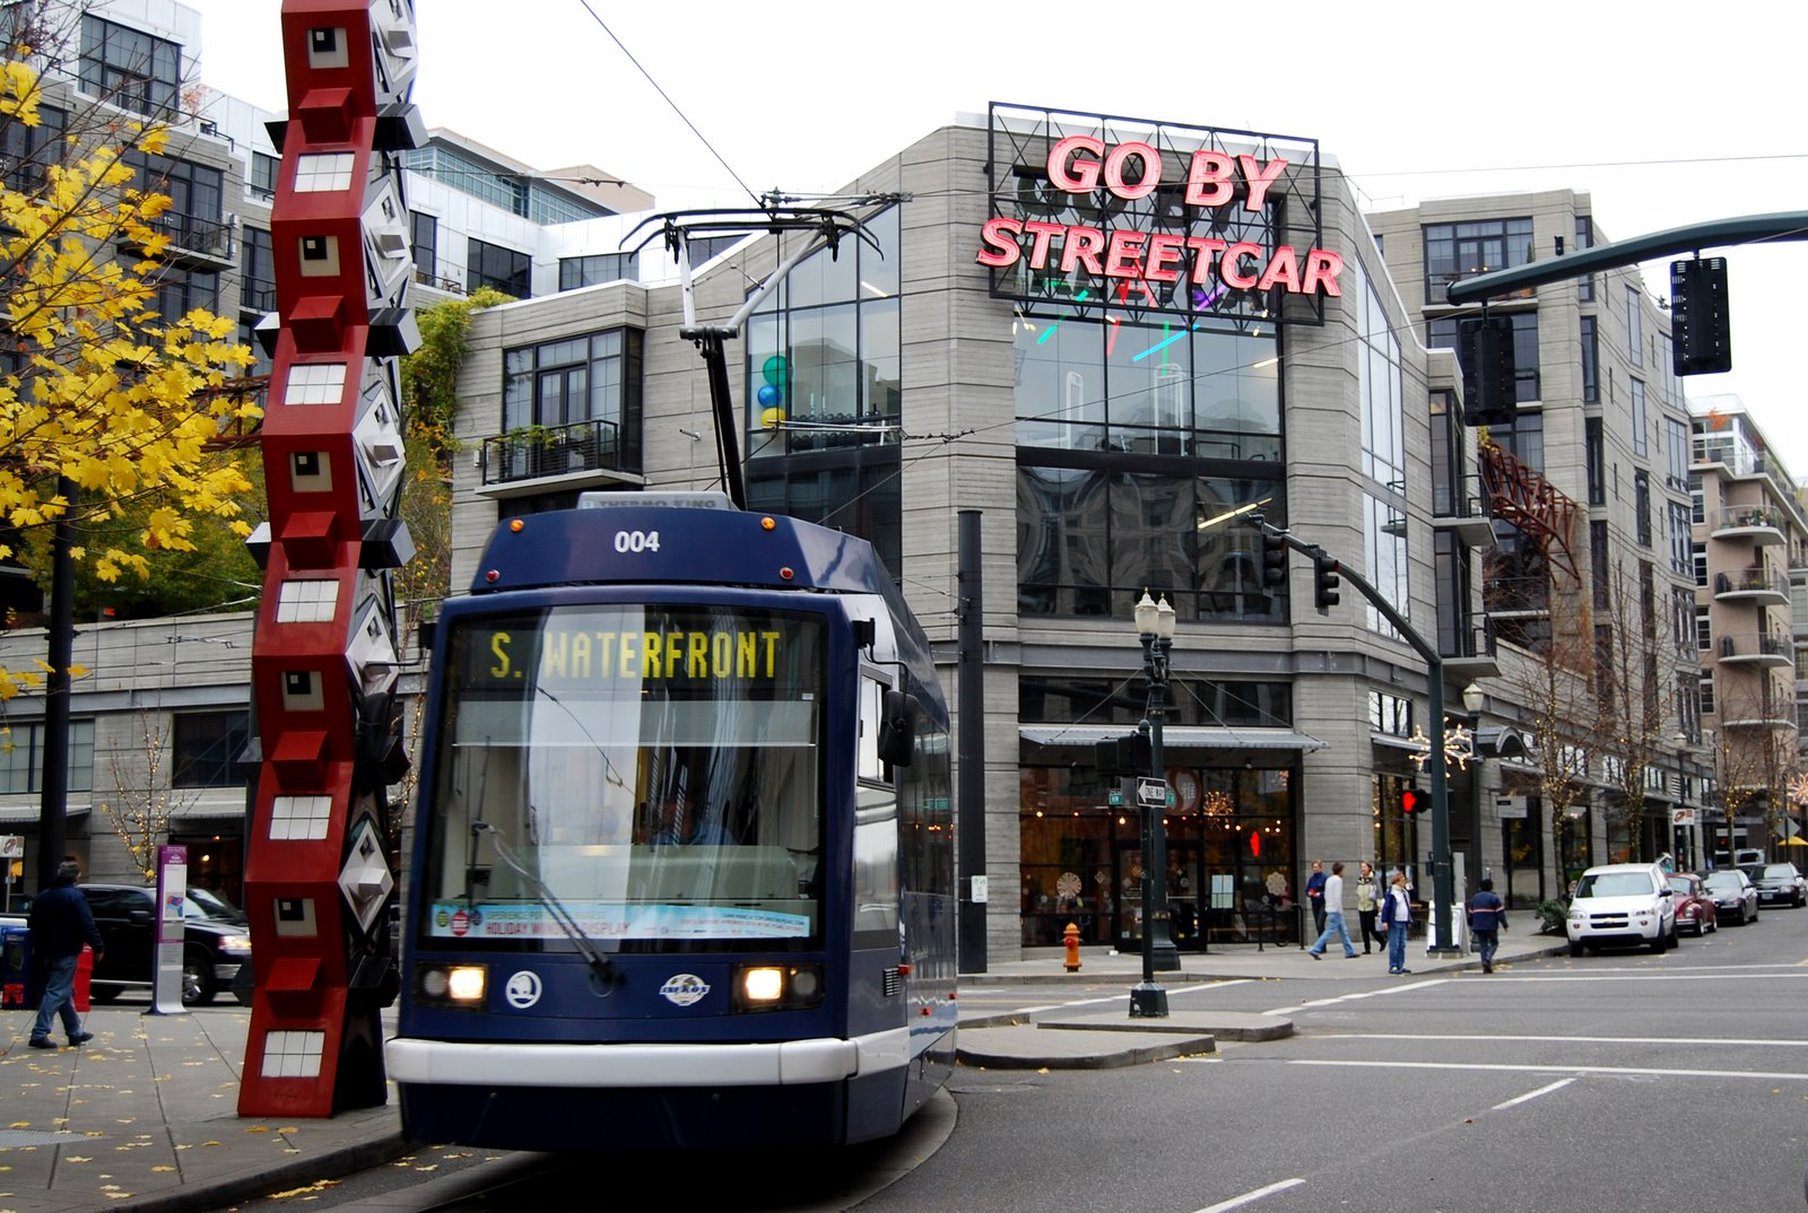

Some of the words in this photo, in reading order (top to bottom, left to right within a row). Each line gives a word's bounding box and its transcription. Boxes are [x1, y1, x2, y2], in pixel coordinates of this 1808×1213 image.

[1047, 135, 1162, 199] GO
[1185, 150, 1288, 211] BY
[976, 217, 1343, 297] STREETCAR
[614, 531, 660, 552] 004
[490, 632, 523, 678] S.
[543, 632, 780, 678] WATERFRONT
